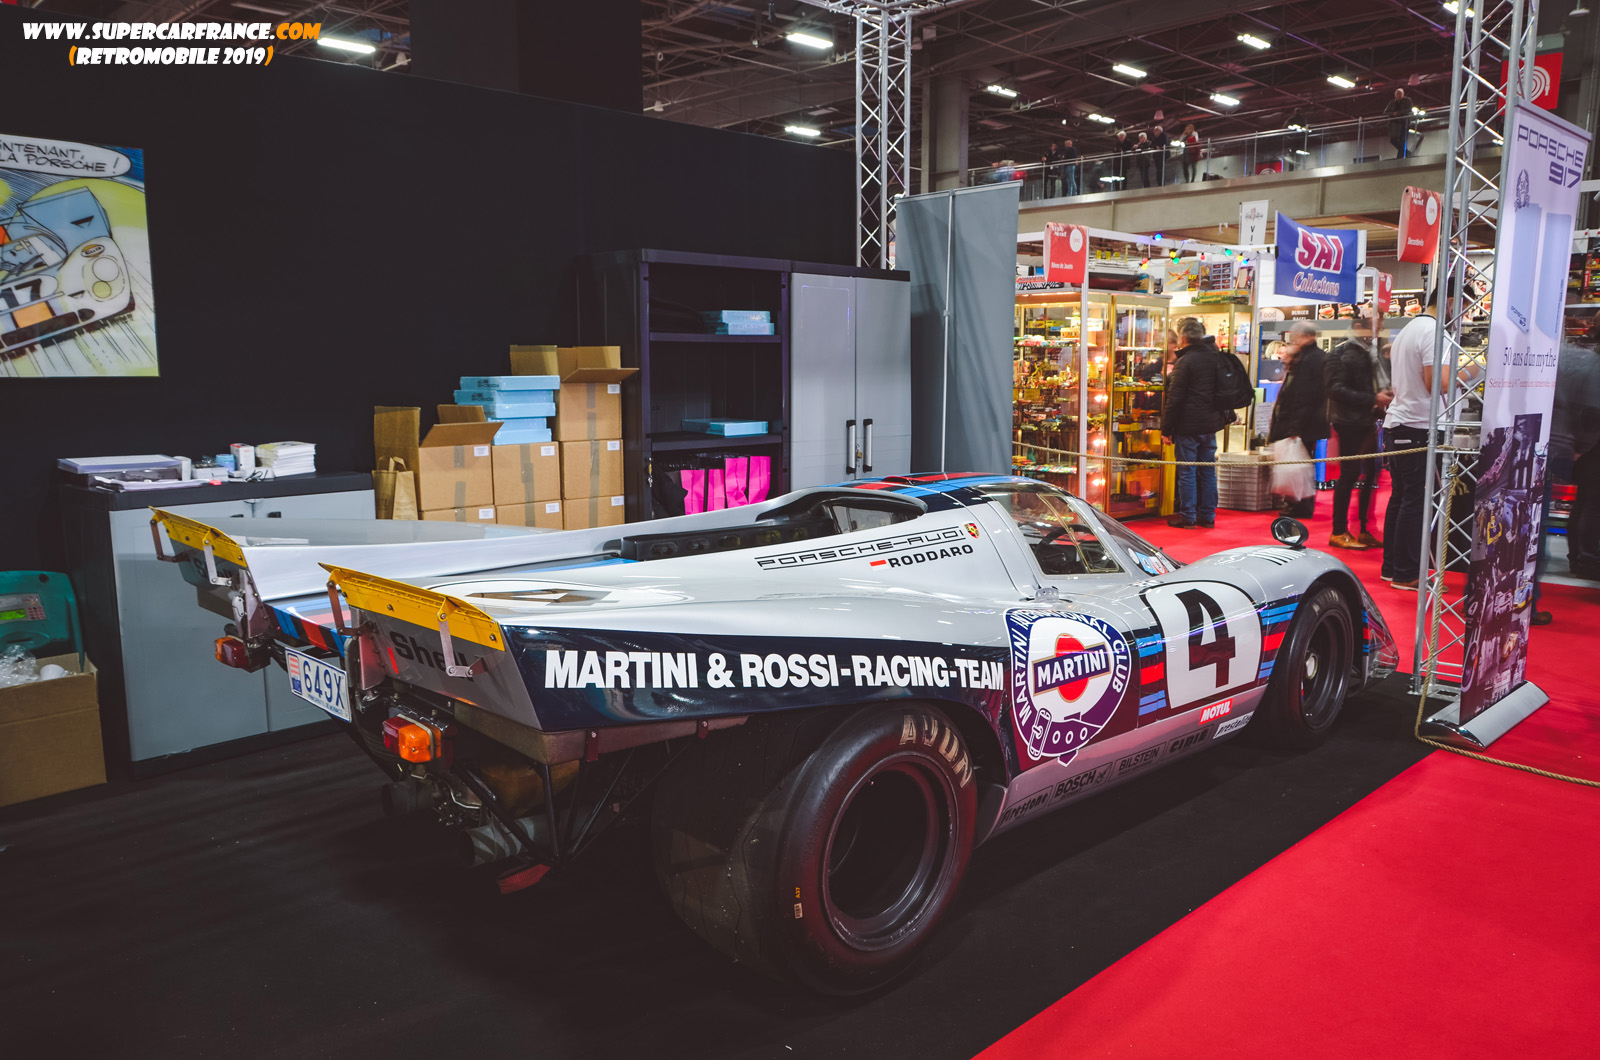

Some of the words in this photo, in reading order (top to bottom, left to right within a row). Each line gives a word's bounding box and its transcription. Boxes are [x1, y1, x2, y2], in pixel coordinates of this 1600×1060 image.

[1518, 124, 1583, 168] PORSCHE
[24, 154, 107, 172] PORSCHE
[1549, 161, 1581, 188] 917
[1295, 227, 1344, 274] SAI
[1293, 271, 1340, 296] Collections
[1503, 347, 1512, 366] 50
[1512, 353, 1523, 367] ans
[1536, 348, 1556, 373] mythe
[757, 528, 964, 569] PORSCHE-AUDI
[888, 544, 974, 569] RODDARO
[1175, 588, 1236, 689] 4
[303, 659, 345, 709] 649X
[545, 650, 697, 689] MARTINI
[707, 653, 735, 688] &
[742, 653, 1004, 692] ROSSI-RACING-TEAM
[1011, 627, 1033, 726] MARTINI
[1112, 639, 1128, 694] CLUB
[1037, 648, 1107, 688] MARTINI
[1200, 700, 1231, 723] MOTUL
[1118, 747, 1160, 771] BILSTEIN
[1055, 769, 1097, 798] BOSCH
[1000, 792, 1048, 825] Firestone
